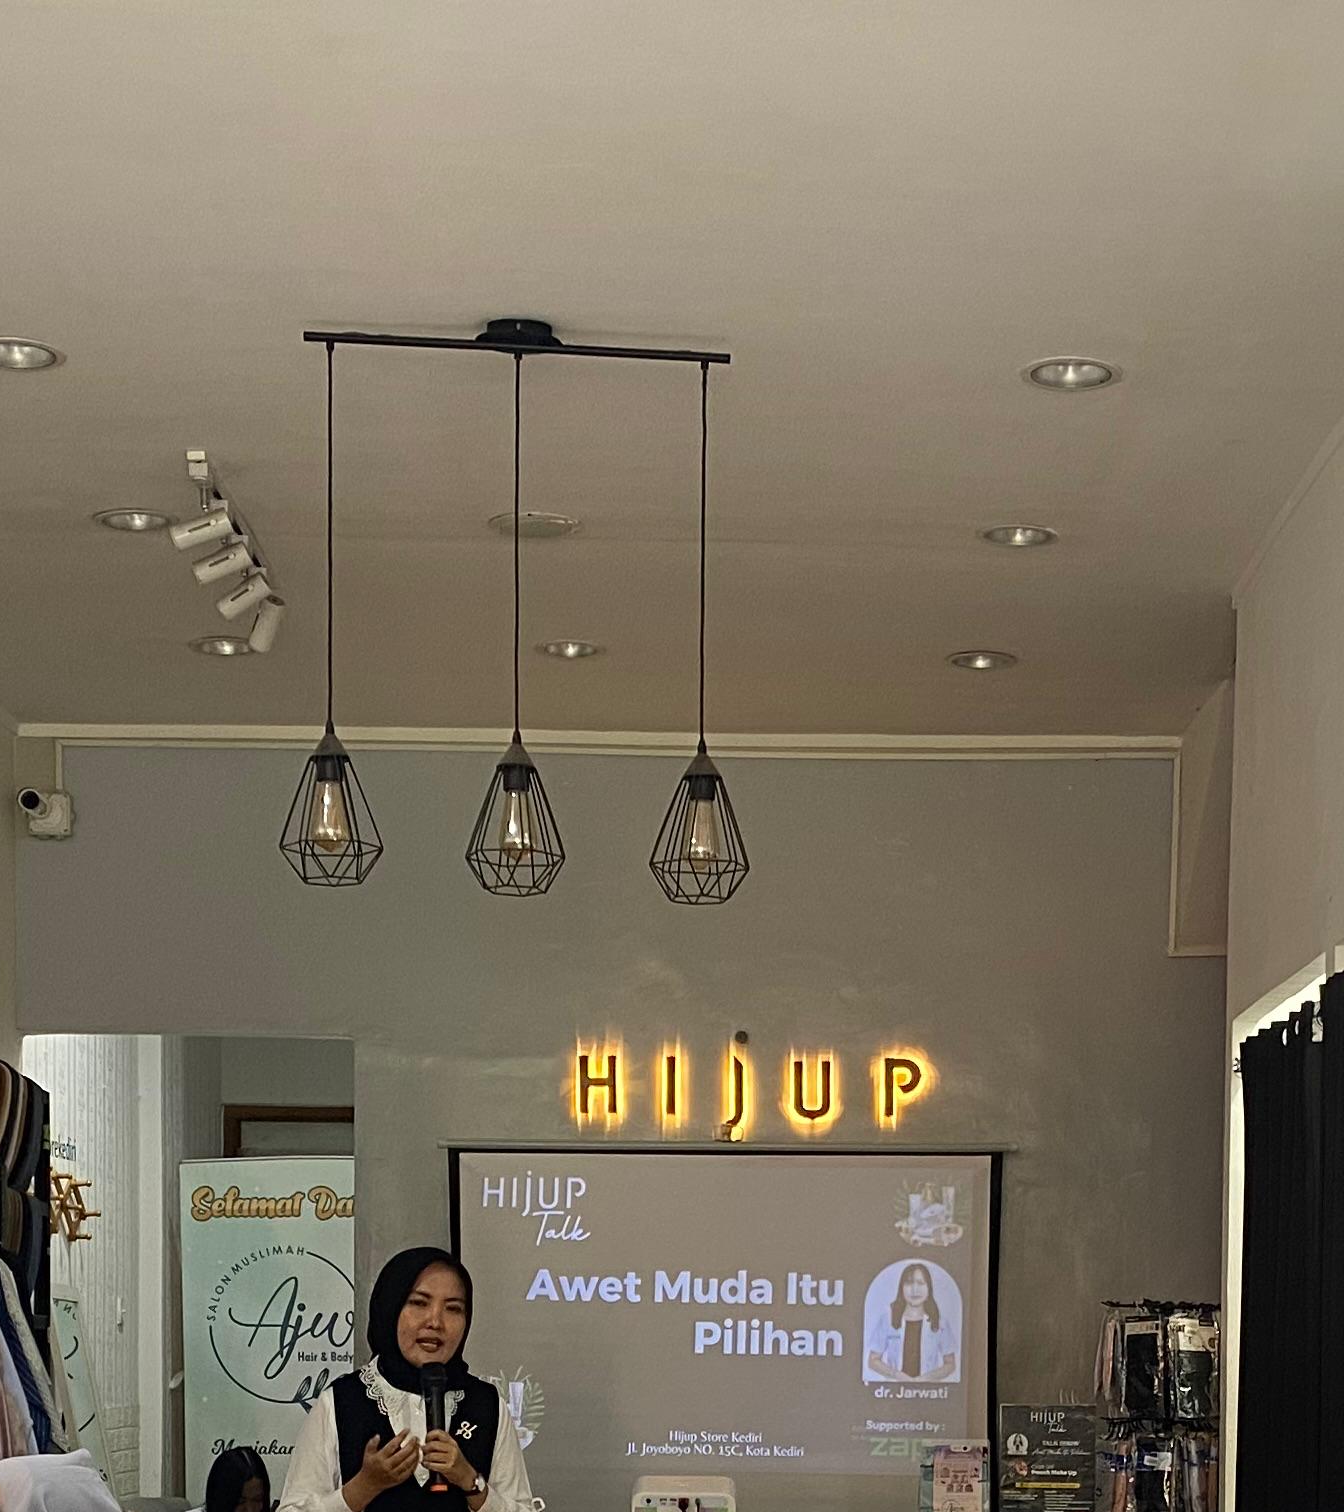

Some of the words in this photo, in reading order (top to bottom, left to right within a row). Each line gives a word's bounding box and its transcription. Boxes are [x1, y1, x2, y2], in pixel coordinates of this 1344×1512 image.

[191, 1185, 305, 1222] Selamat
[307, 1185, 355, 1221] Da
[532, 1211, 591, 1246] Talk
[207, 1275, 231, 1321] SALON
[231, 1245, 305, 1275] MUSLIMAH
[525, 1268, 642, 1303] Awet
[654, 1270, 773, 1305] Muda
[786, 1271, 844, 1306] Itu
[228, 1276, 354, 1380] Ajw
[694, 1318, 844, 1357] Pilihan
[297, 1351, 317, 1362] Hair
[320, 1352, 328, 1362] &
[330, 1351, 354, 1364] Body
[874, 1386, 893, 1399] dr.
[896, 1386, 949, 1400] Jarwati
[668, 1430, 698, 1445] Hijup
[700, 1431, 729, 1443] Store
[731, 1431, 763, 1443] Kediri
[865, 1420, 924, 1433] Supported
[925, 1421, 940, 1433] by
[625, 1442, 637, 1456] Jl.
[640, 1443, 691, 1457] Joyoboyo
[693, 1444, 716, 1456] NO.
[745, 1446, 771, 1457] Kota
[773, 1446, 805, 1458] Kediri
